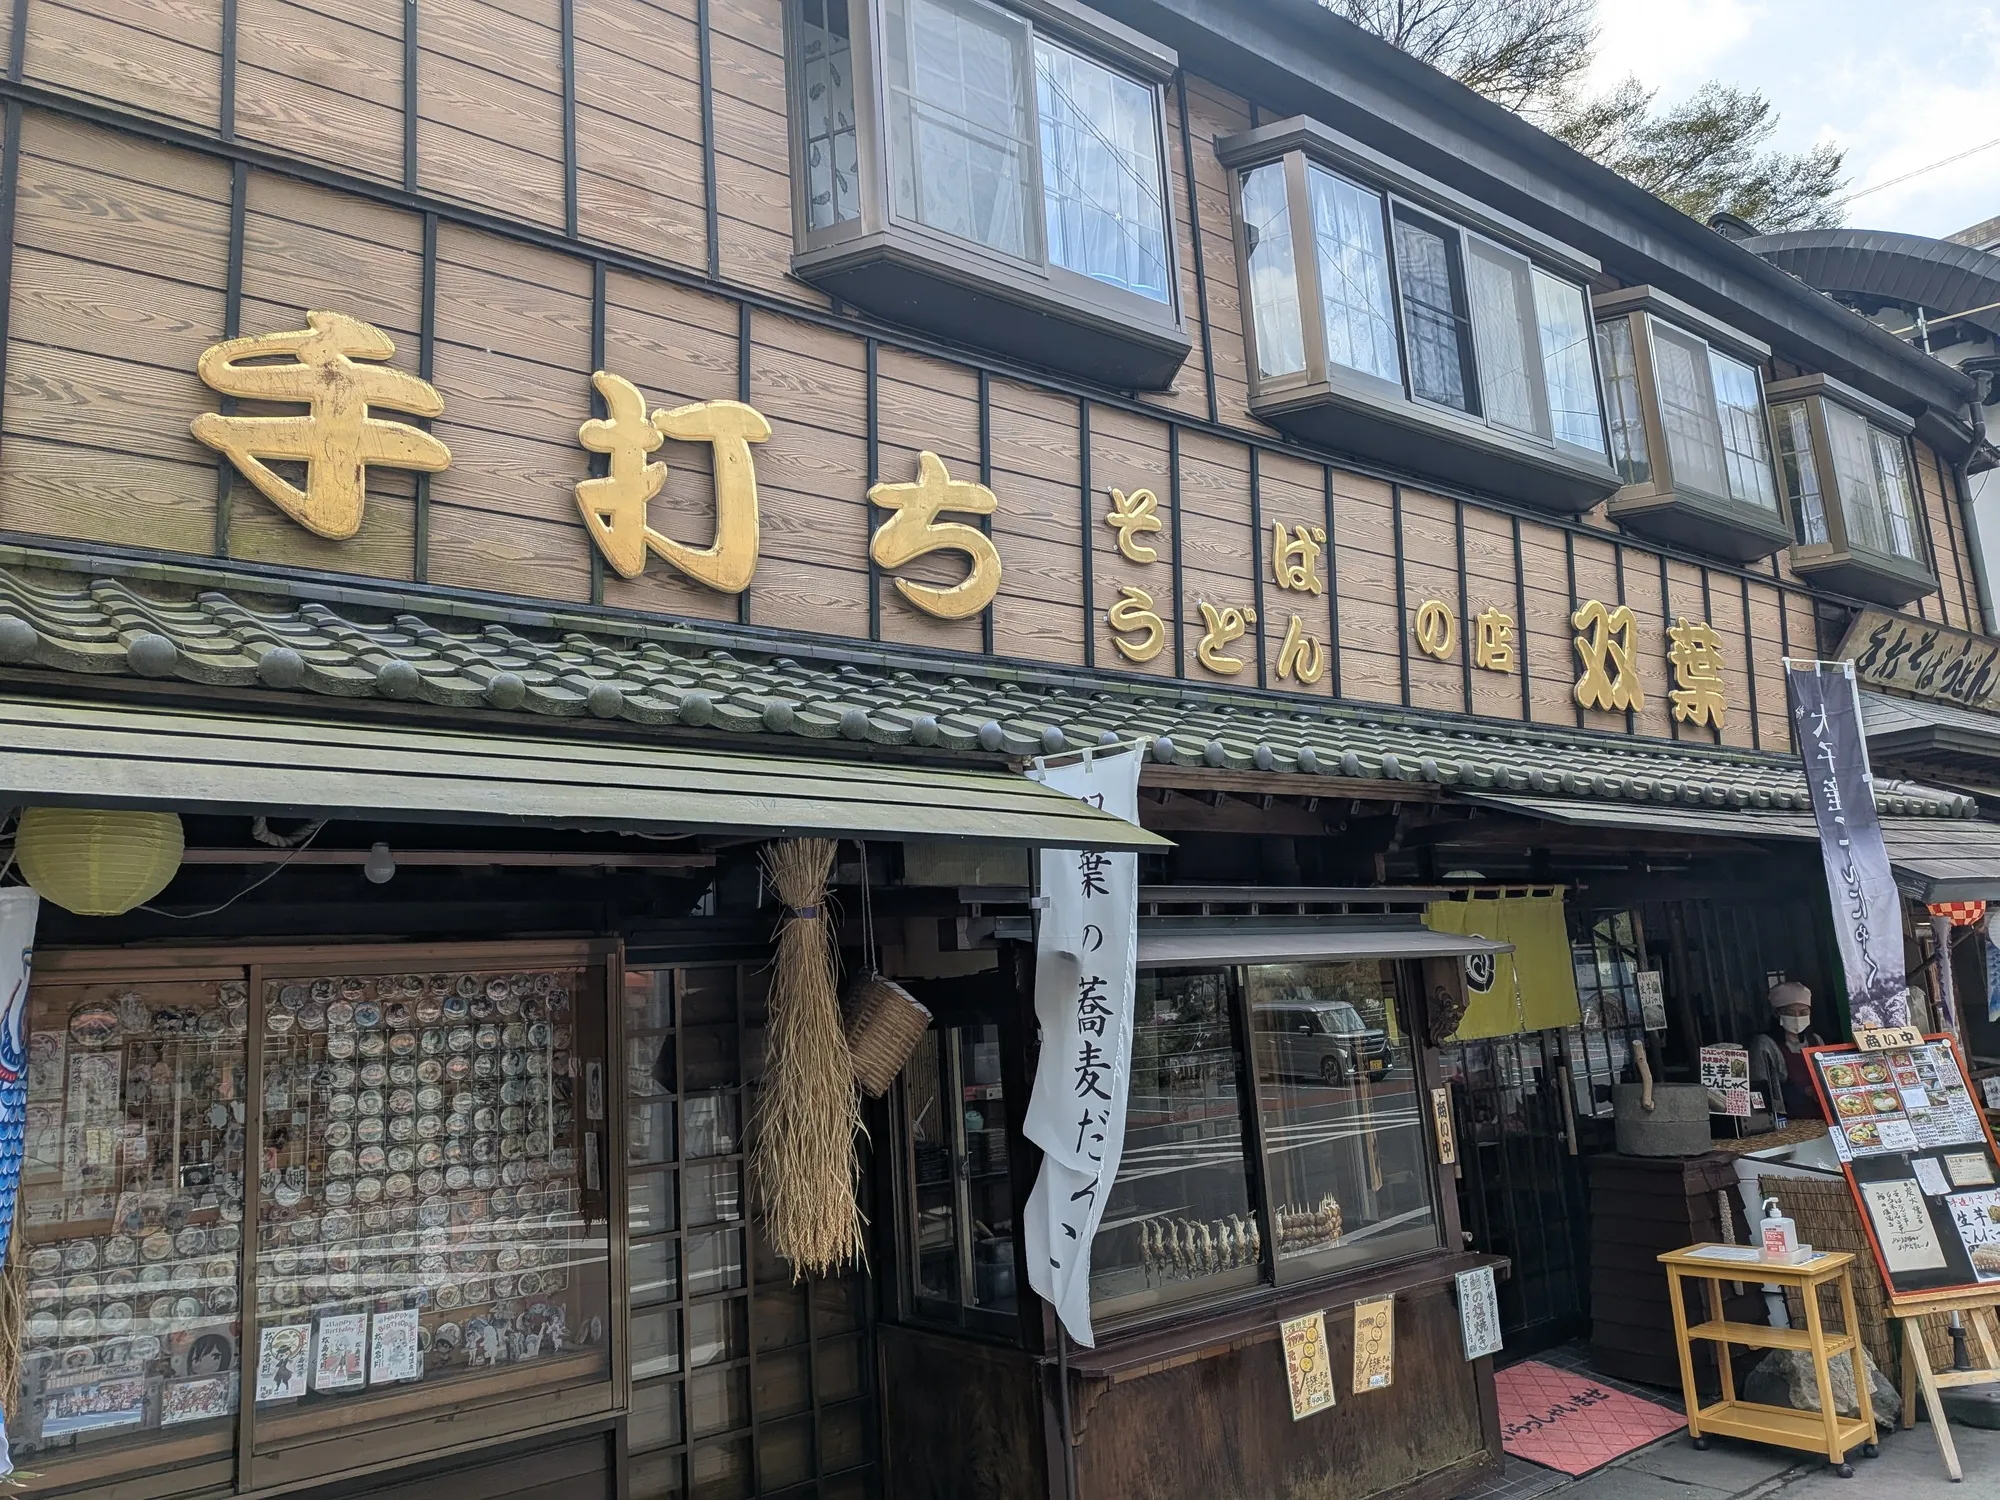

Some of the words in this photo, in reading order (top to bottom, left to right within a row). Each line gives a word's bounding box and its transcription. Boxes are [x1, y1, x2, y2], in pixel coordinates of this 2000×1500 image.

[189, 310, 1003, 621] 手打ち
[1105, 486, 1328, 597] そば
[1107, 585, 1325, 686] うどん
[1414, 597, 1516, 674] の店
[1571, 597, 1728, 731] 双葉
[1864, 1031, 1916, 1049] 商い中
[1702, 1063, 1731, 1078] 生芋
[1702, 1078, 1749, 1091] こんにゃく
[1957, 1206, 1988, 1228] 生芋
[1961, 1228, 2000, 1244] こんに
